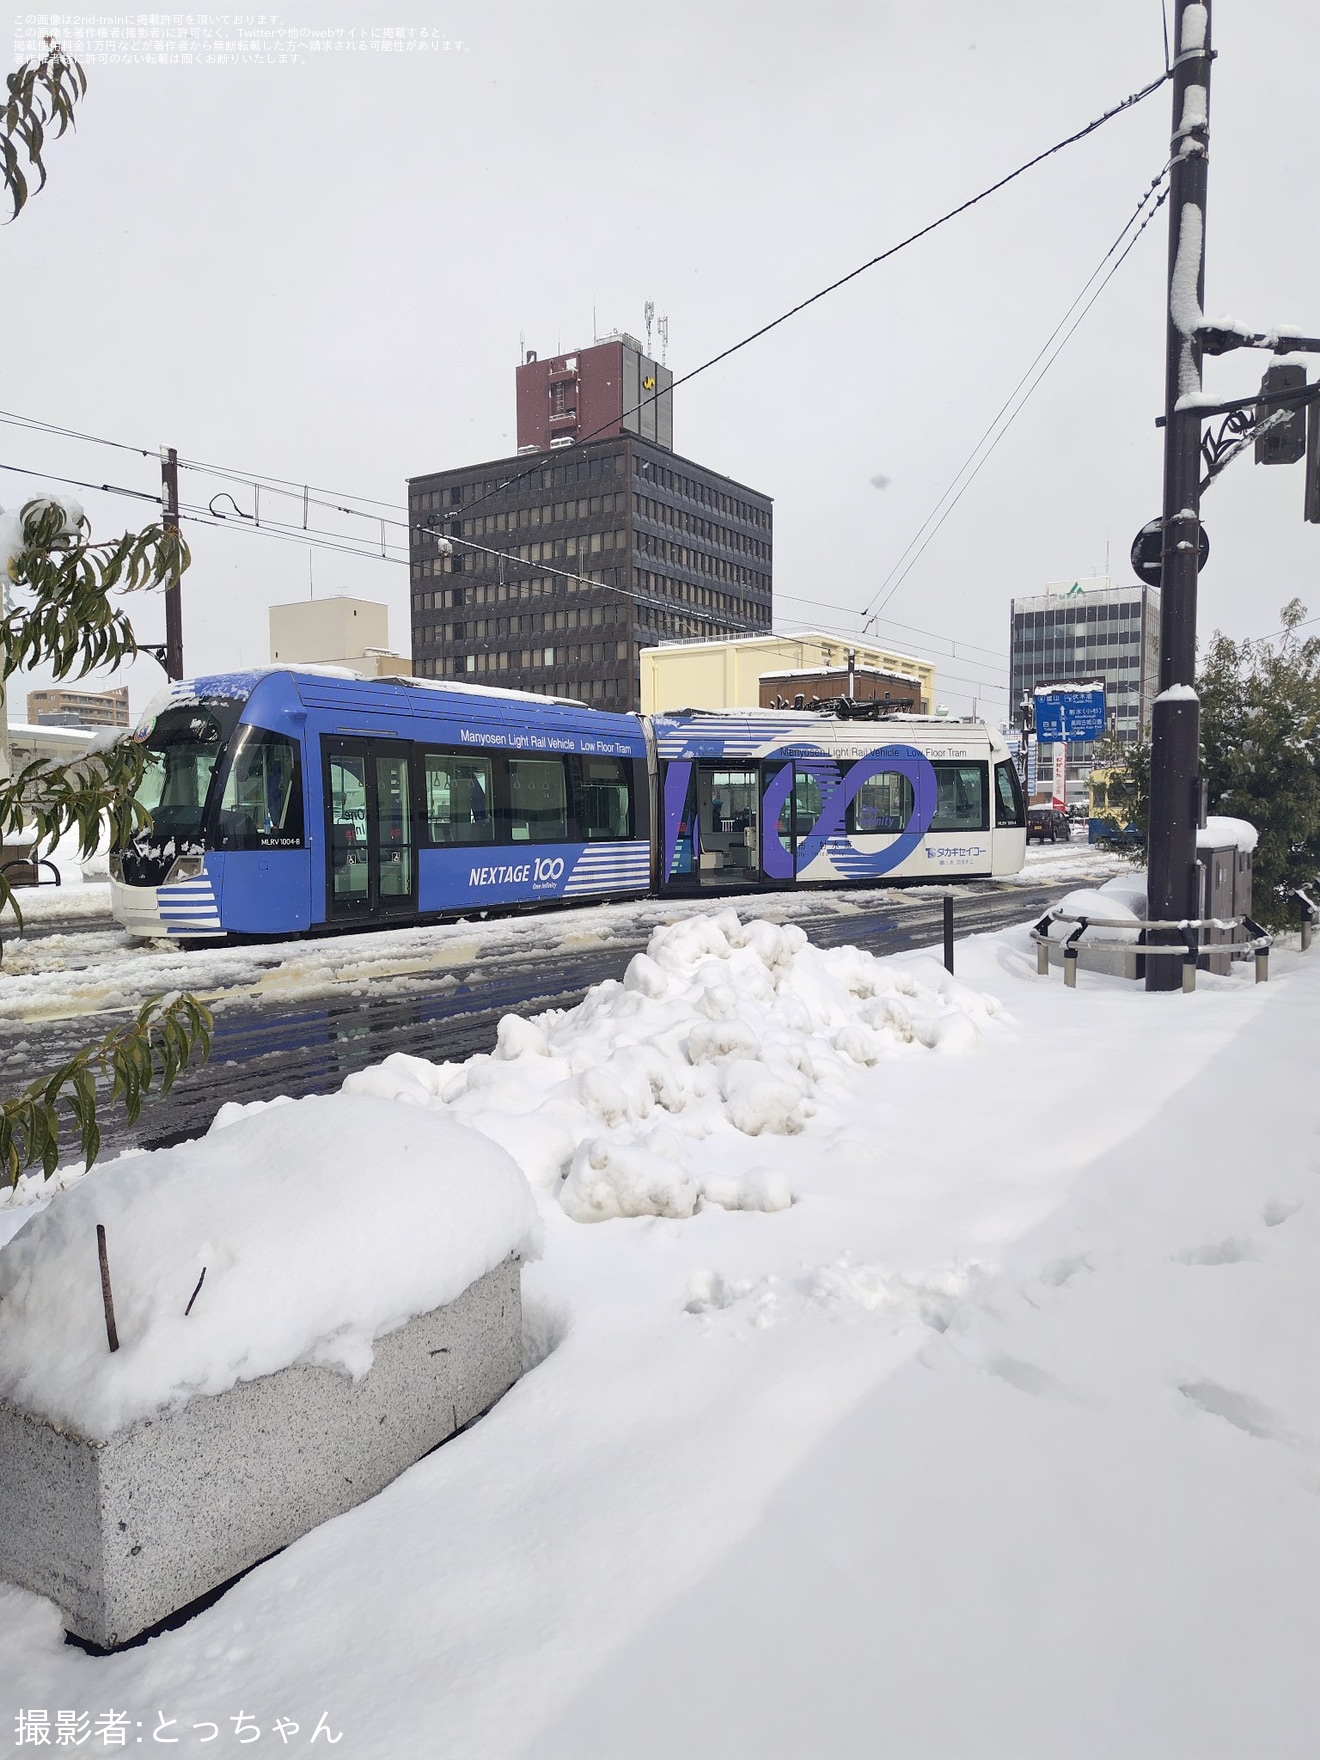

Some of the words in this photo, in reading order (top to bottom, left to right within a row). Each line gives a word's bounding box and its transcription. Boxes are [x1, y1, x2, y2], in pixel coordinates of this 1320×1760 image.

[460, 729, 507, 745] Manyosen
[508, 734, 530, 749] Light
[531, 737, 547, 748] Rail
[547, 737, 575, 750] Vehicle
[580, 740, 596, 751] Low
[597, 742, 615, 753] Floor
[615, 741, 632, 754] Tram
[828, 748, 848, 757] Light
[851, 748, 867, 756] Rail
[869, 748, 900, 757] Vehicle
[906, 748, 923, 757] Low
[925, 748, 946, 757] Floor
[948, 748, 968, 757] Tram
[937, 847, 986, 858] タカギセイコー
[469, 865, 530, 886] NEXTAGE
[533, 857, 564, 882] 100
